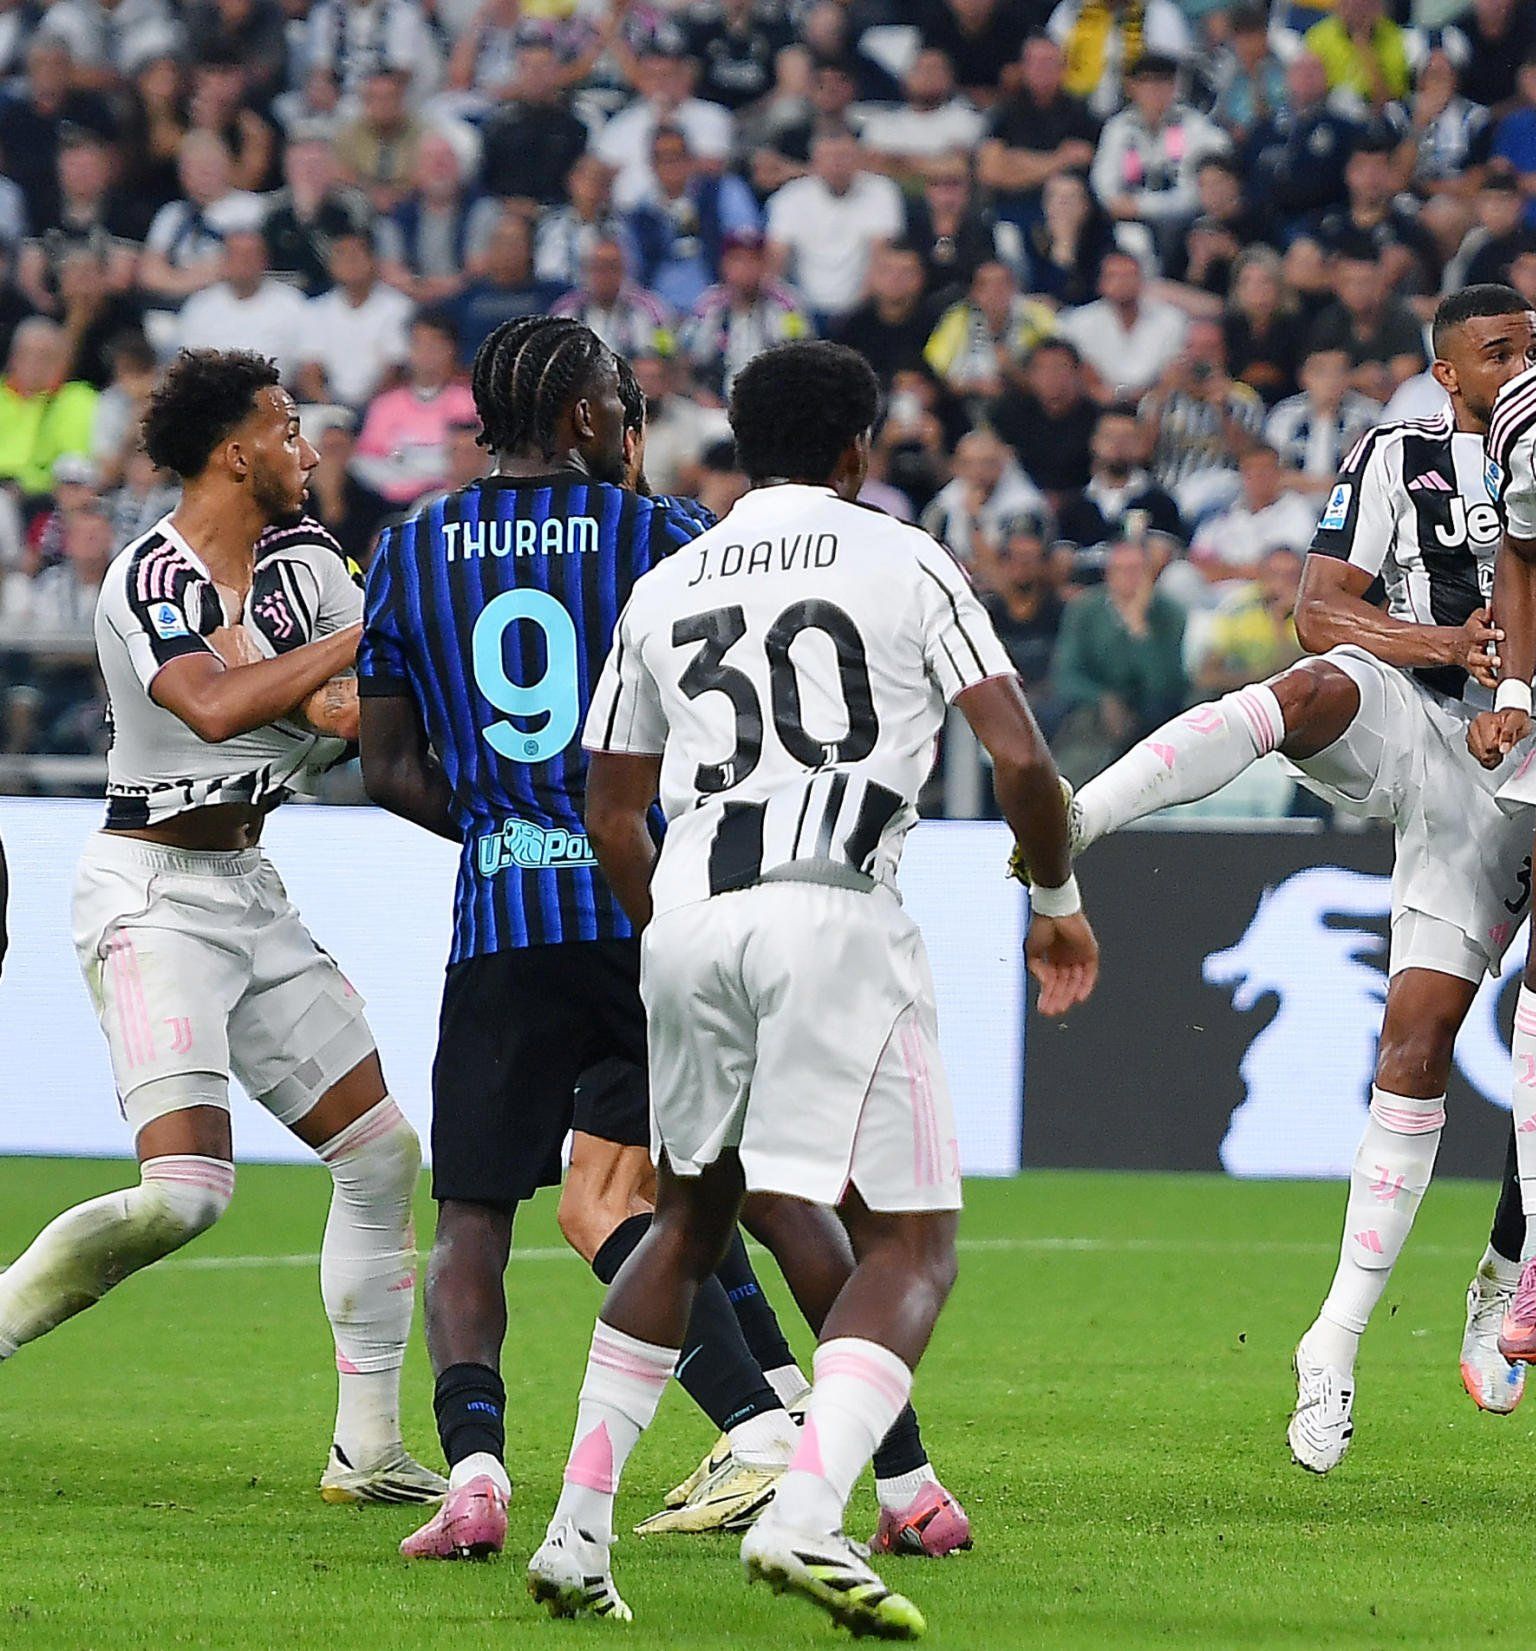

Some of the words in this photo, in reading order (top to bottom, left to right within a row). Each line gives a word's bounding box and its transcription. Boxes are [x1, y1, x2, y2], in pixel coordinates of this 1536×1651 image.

[442, 517, 599, 562] THURAM
[1434, 496, 1500, 548] Je
[688, 533, 838, 587] J.DAVID
[472, 588, 580, 763] 9
[672, 598, 880, 793] 30
